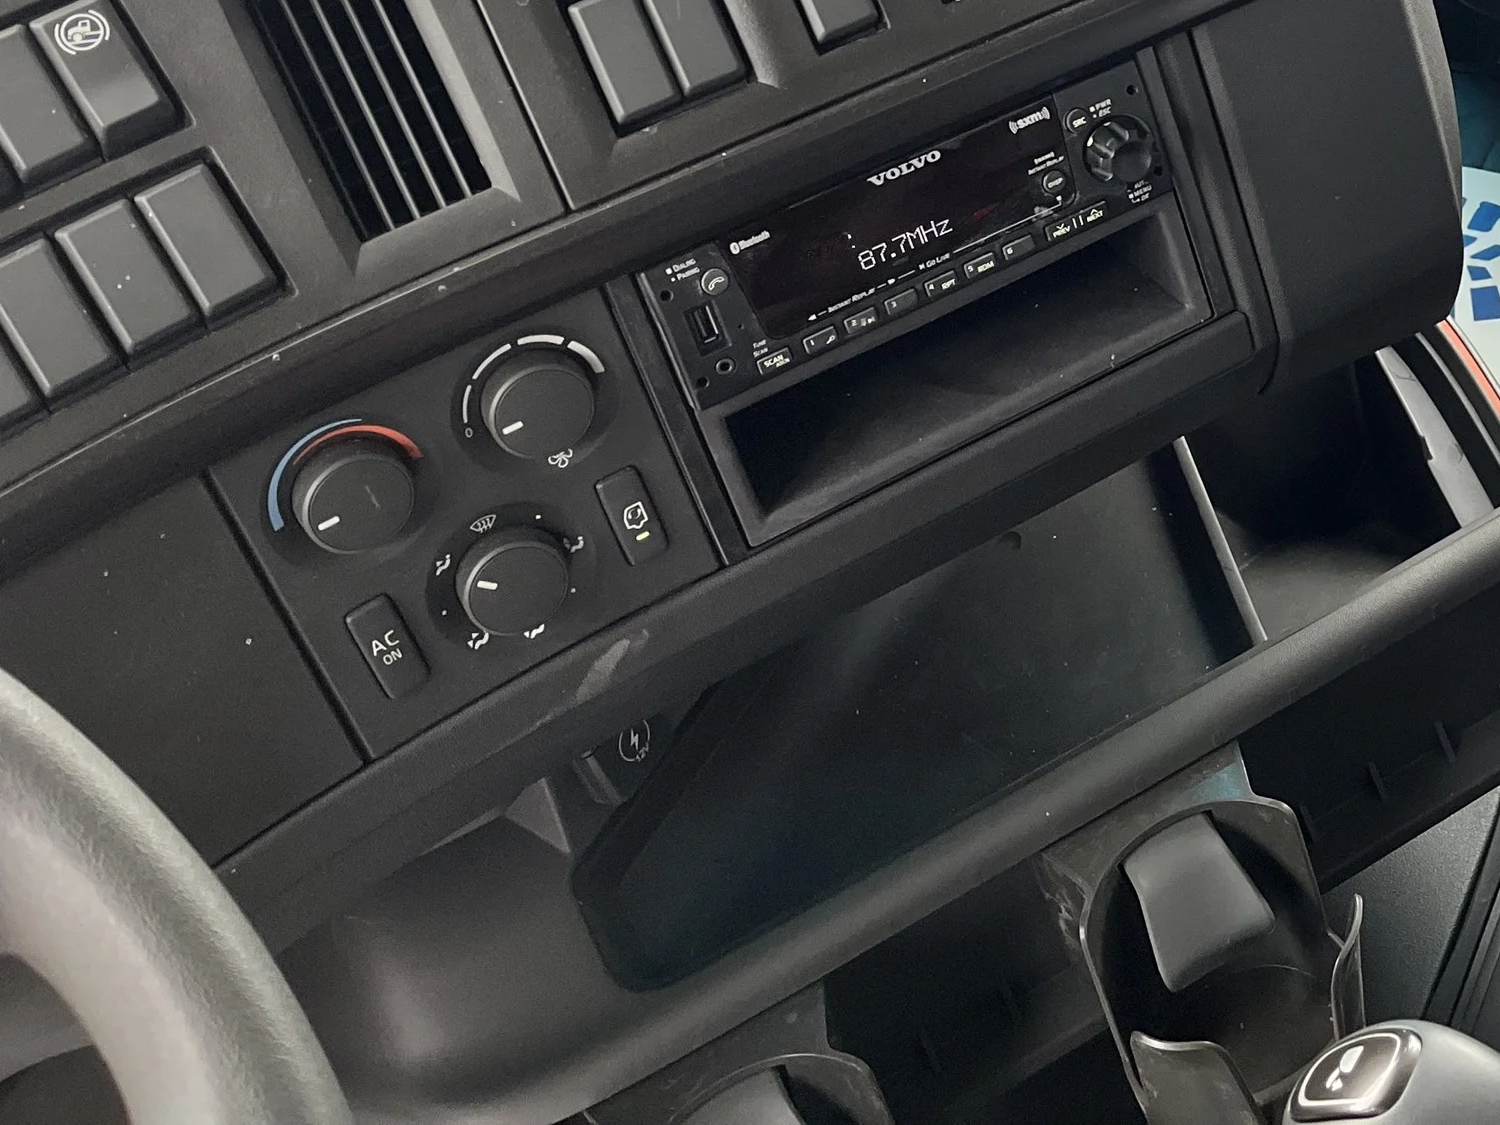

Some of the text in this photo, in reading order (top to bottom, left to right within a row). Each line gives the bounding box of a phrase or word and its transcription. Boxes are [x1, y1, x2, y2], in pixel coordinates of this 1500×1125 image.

[1072, 116, 1087, 128] SRC
[866, 150, 941, 186] VOLVO
[857, 218, 954, 271] 87.7MHz
[941, 278, 957, 291] RPT
[763, 354, 784, 368] SCAN
[383, 648, 402, 666] ON
